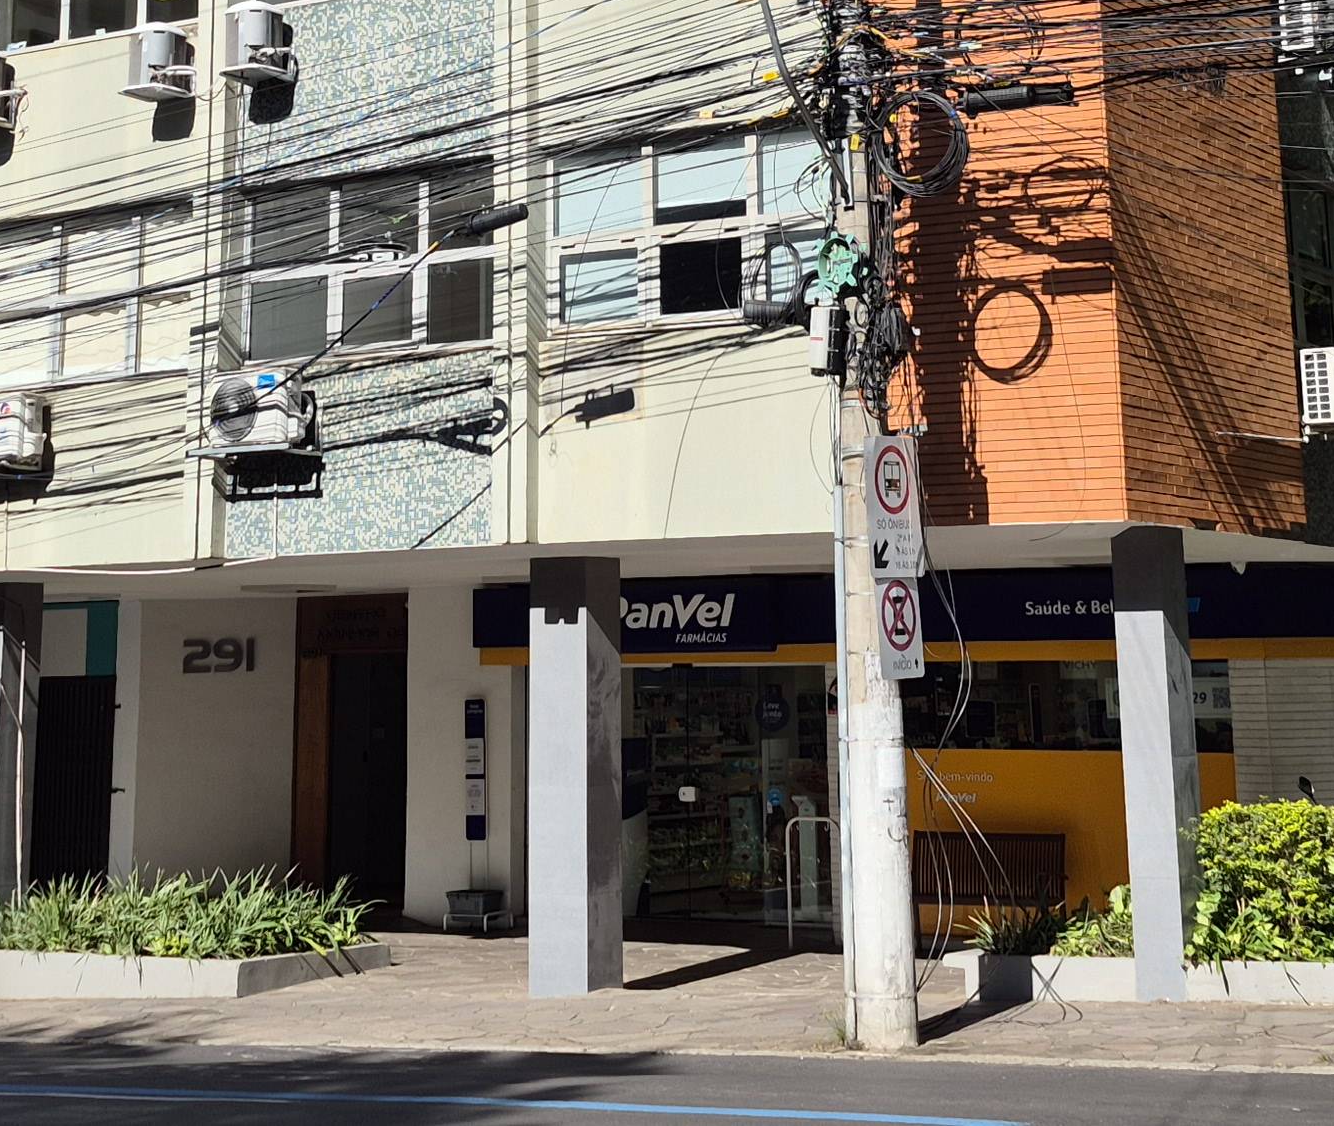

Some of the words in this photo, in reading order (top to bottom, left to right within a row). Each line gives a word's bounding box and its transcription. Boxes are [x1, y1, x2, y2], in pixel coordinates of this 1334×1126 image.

[1025, 600, 1071, 615] Saúde
[1074, 600, 1087, 615] &
[675, 631, 728, 644] FARMÁCIAS
[182, 637, 255, 674] 291
